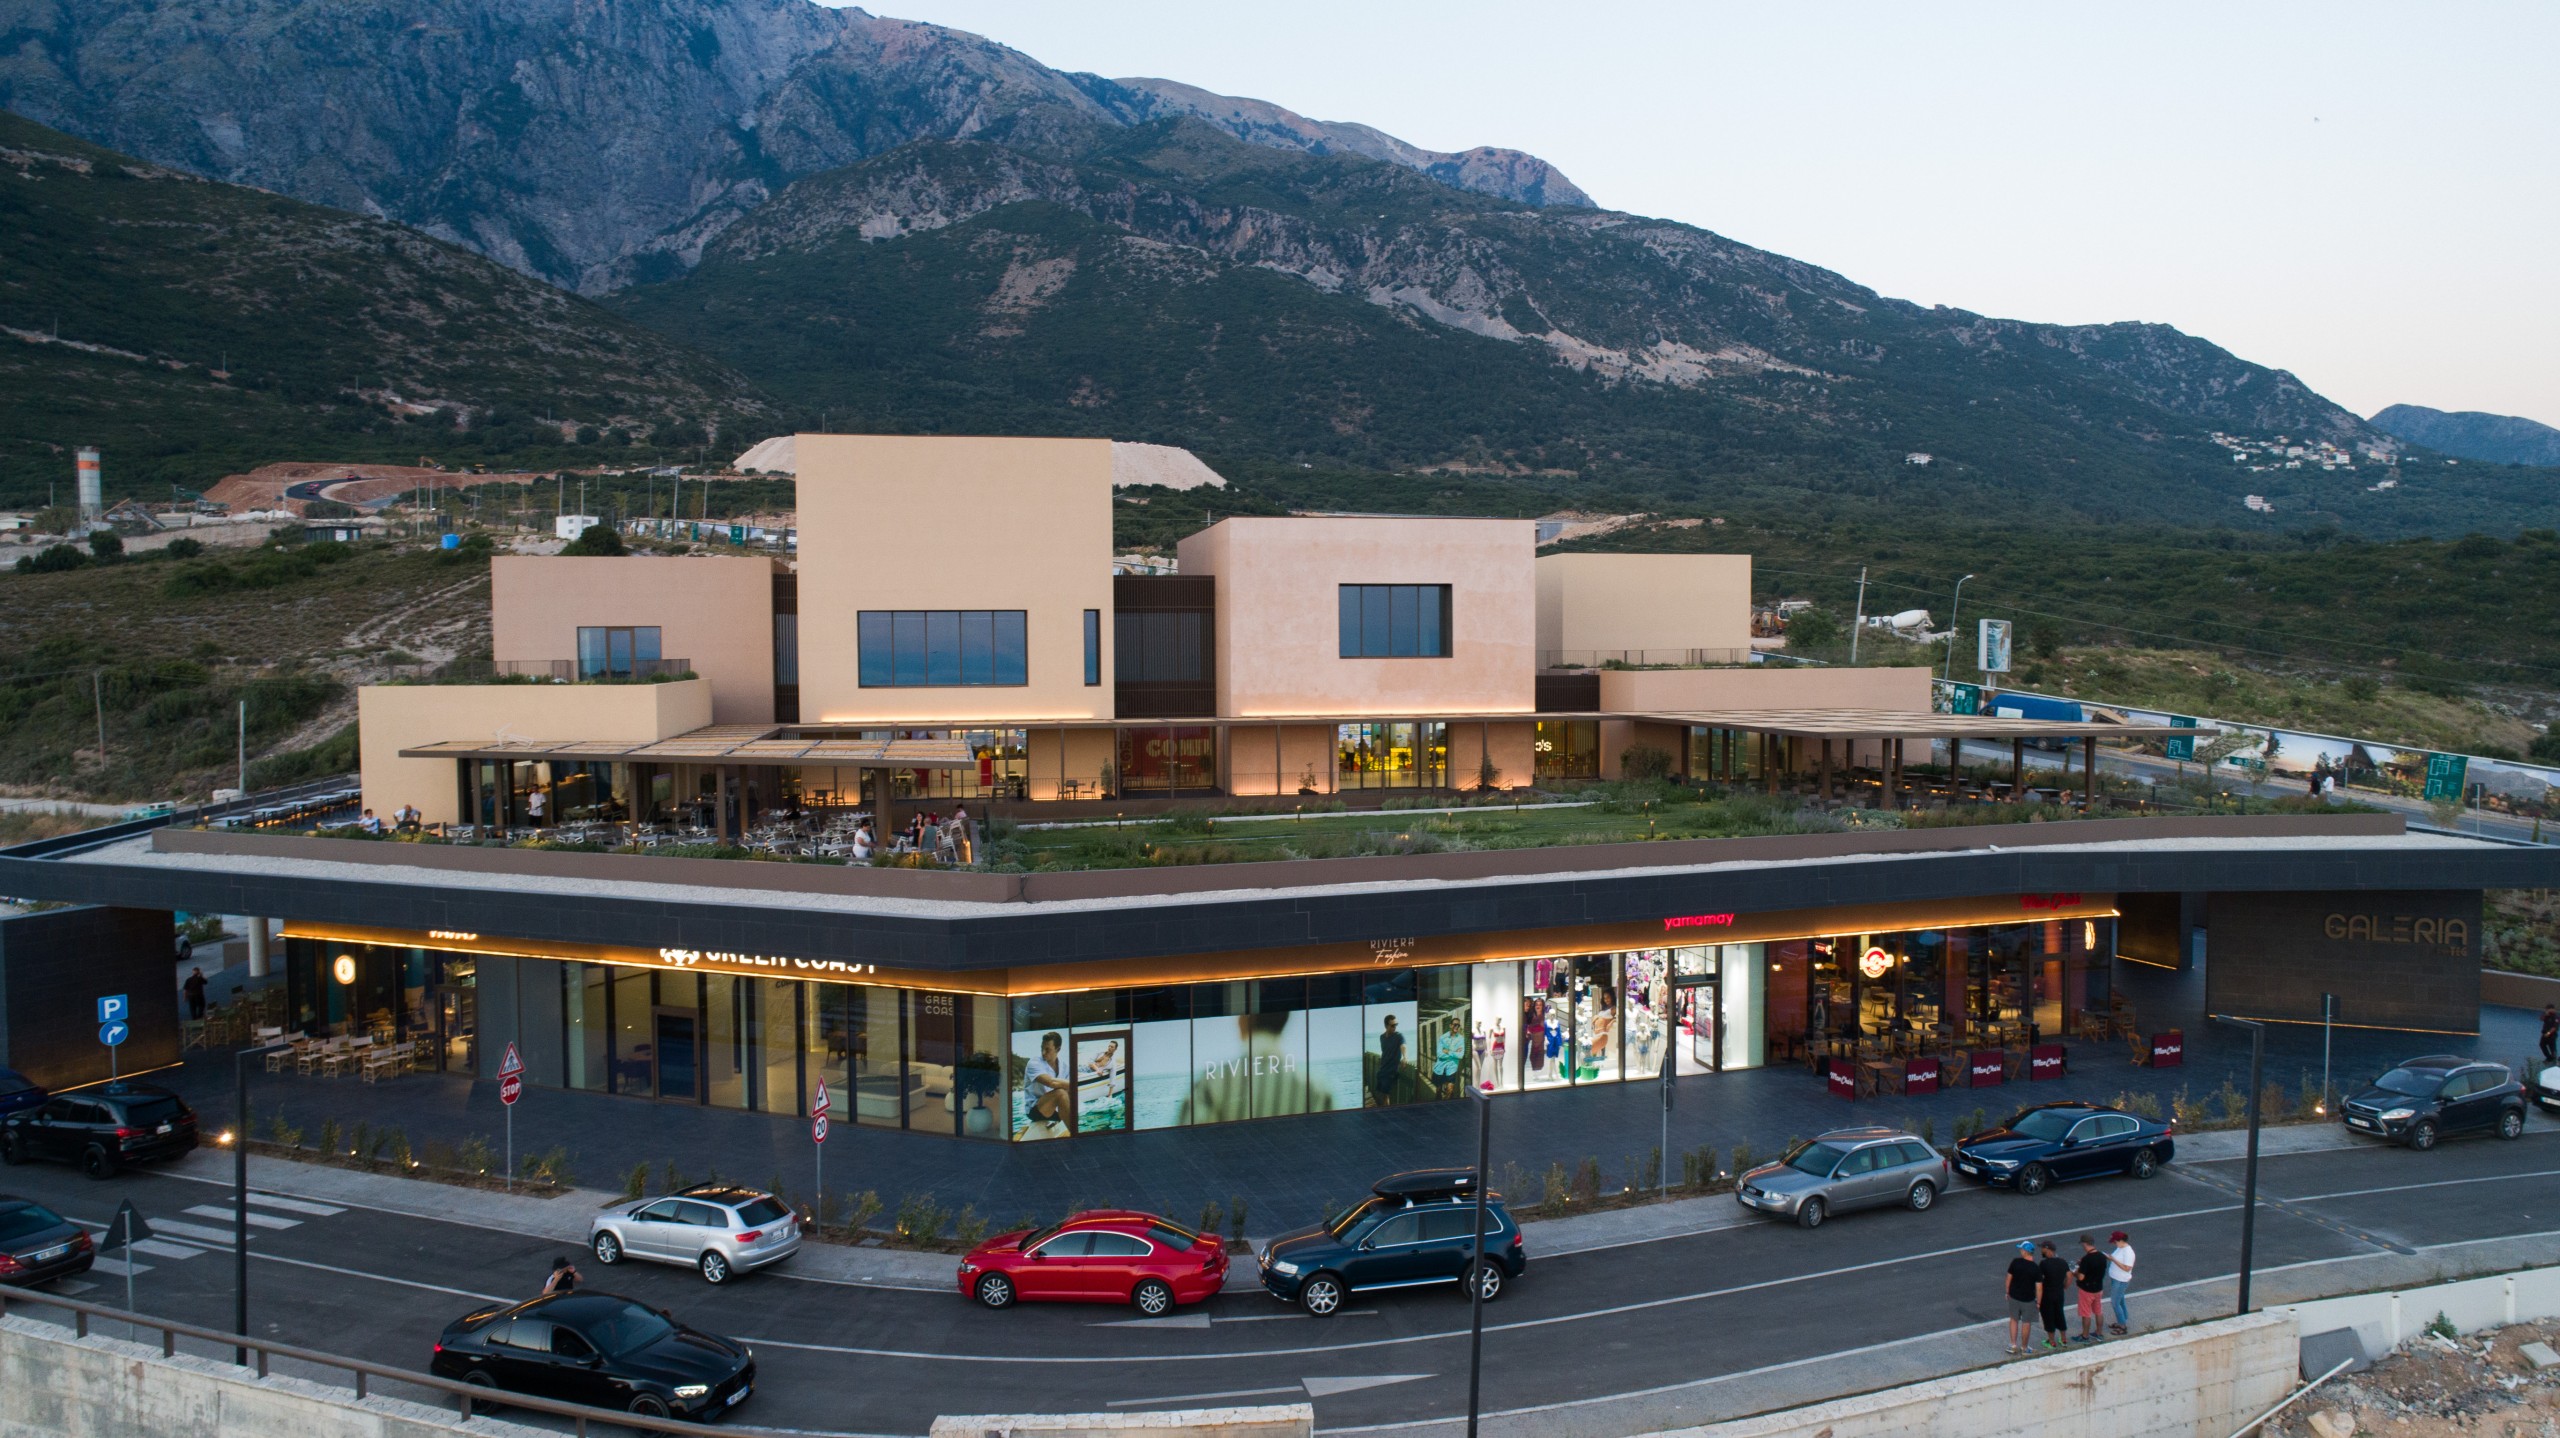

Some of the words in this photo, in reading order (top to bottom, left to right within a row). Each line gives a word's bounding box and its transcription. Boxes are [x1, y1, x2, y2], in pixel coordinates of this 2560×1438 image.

[1664, 913, 1735, 931] yamamay
[2324, 913, 2468, 945] GALERIA
[1370, 937, 1415, 949] RIVIERA
[104, 999, 121, 1019] P
[925, 995, 953, 1006] GREE
[925, 1005, 953, 1016] COAS
[1205, 1053, 1296, 1080] RIVIERA
[502, 1082, 521, 1098] STOP
[816, 1119, 826, 1137] 20
